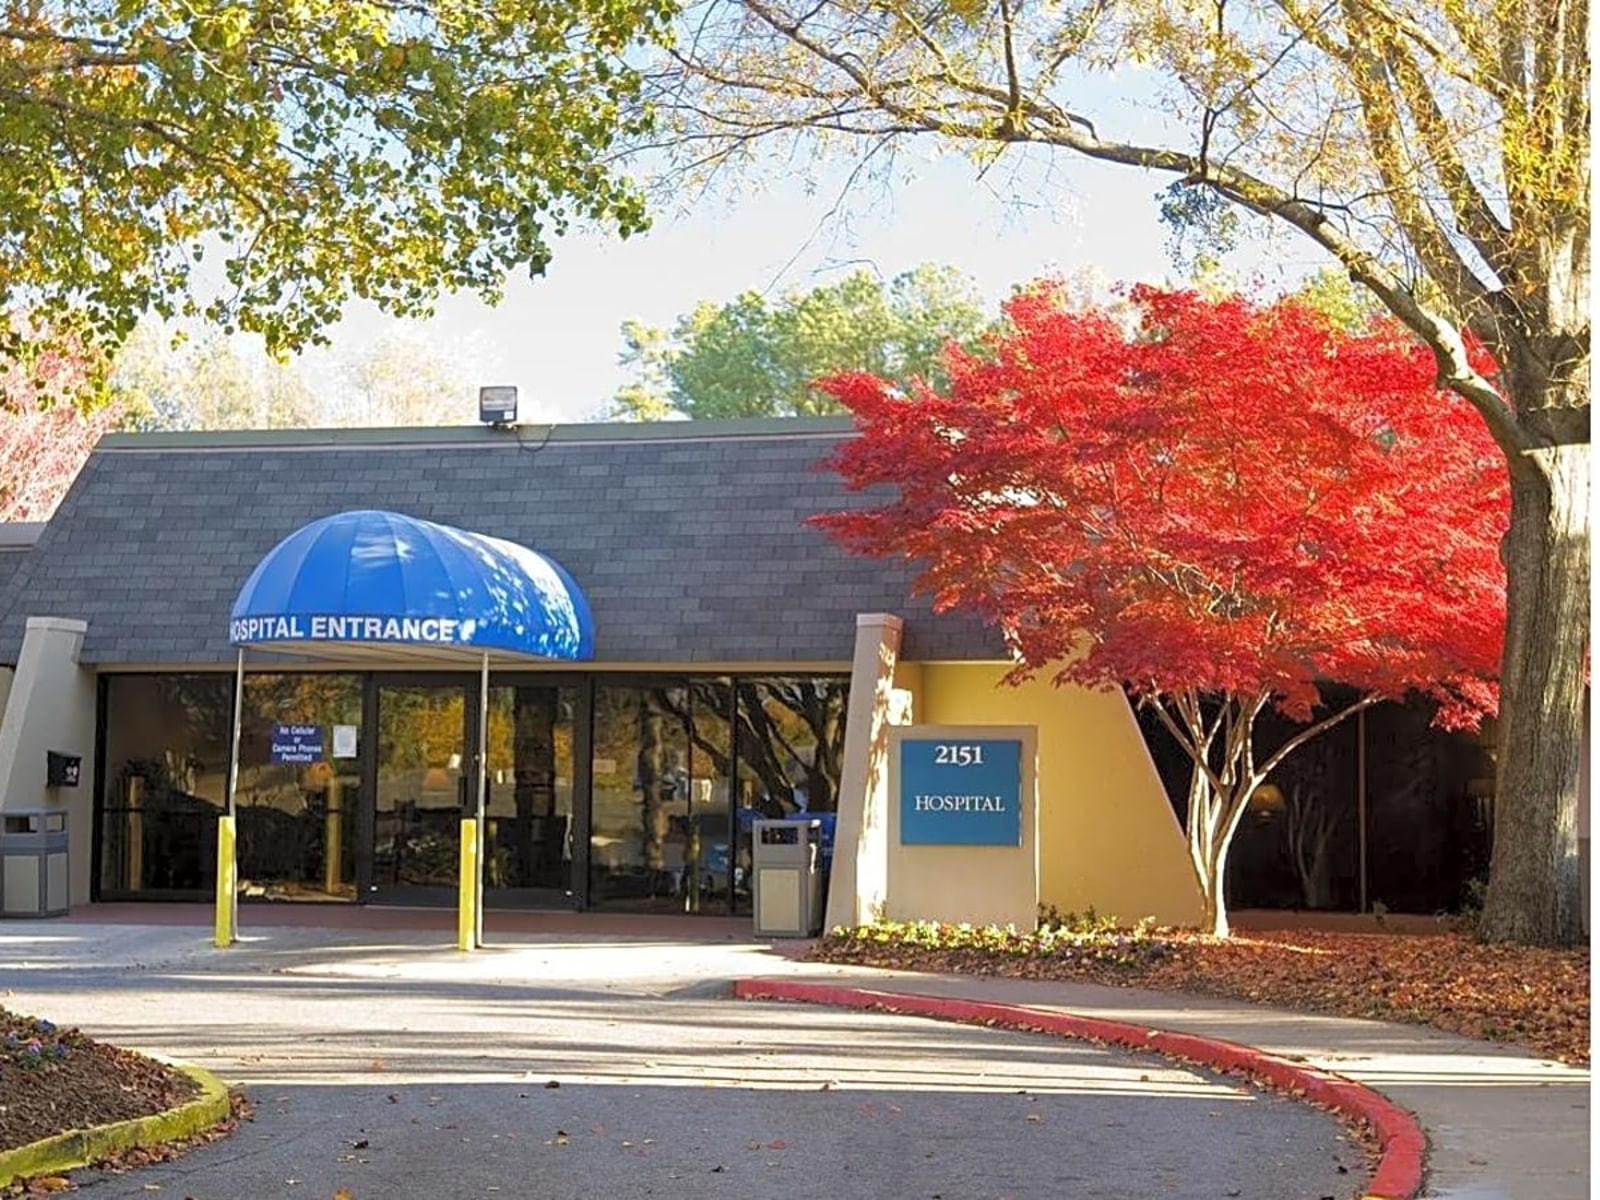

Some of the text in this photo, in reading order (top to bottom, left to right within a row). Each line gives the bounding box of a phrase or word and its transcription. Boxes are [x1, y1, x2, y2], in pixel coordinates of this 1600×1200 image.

[311, 617, 457, 641] ENTRANCE
[935, 745, 983, 766] 2151
[915, 795, 1005, 811] HOSPITAL
